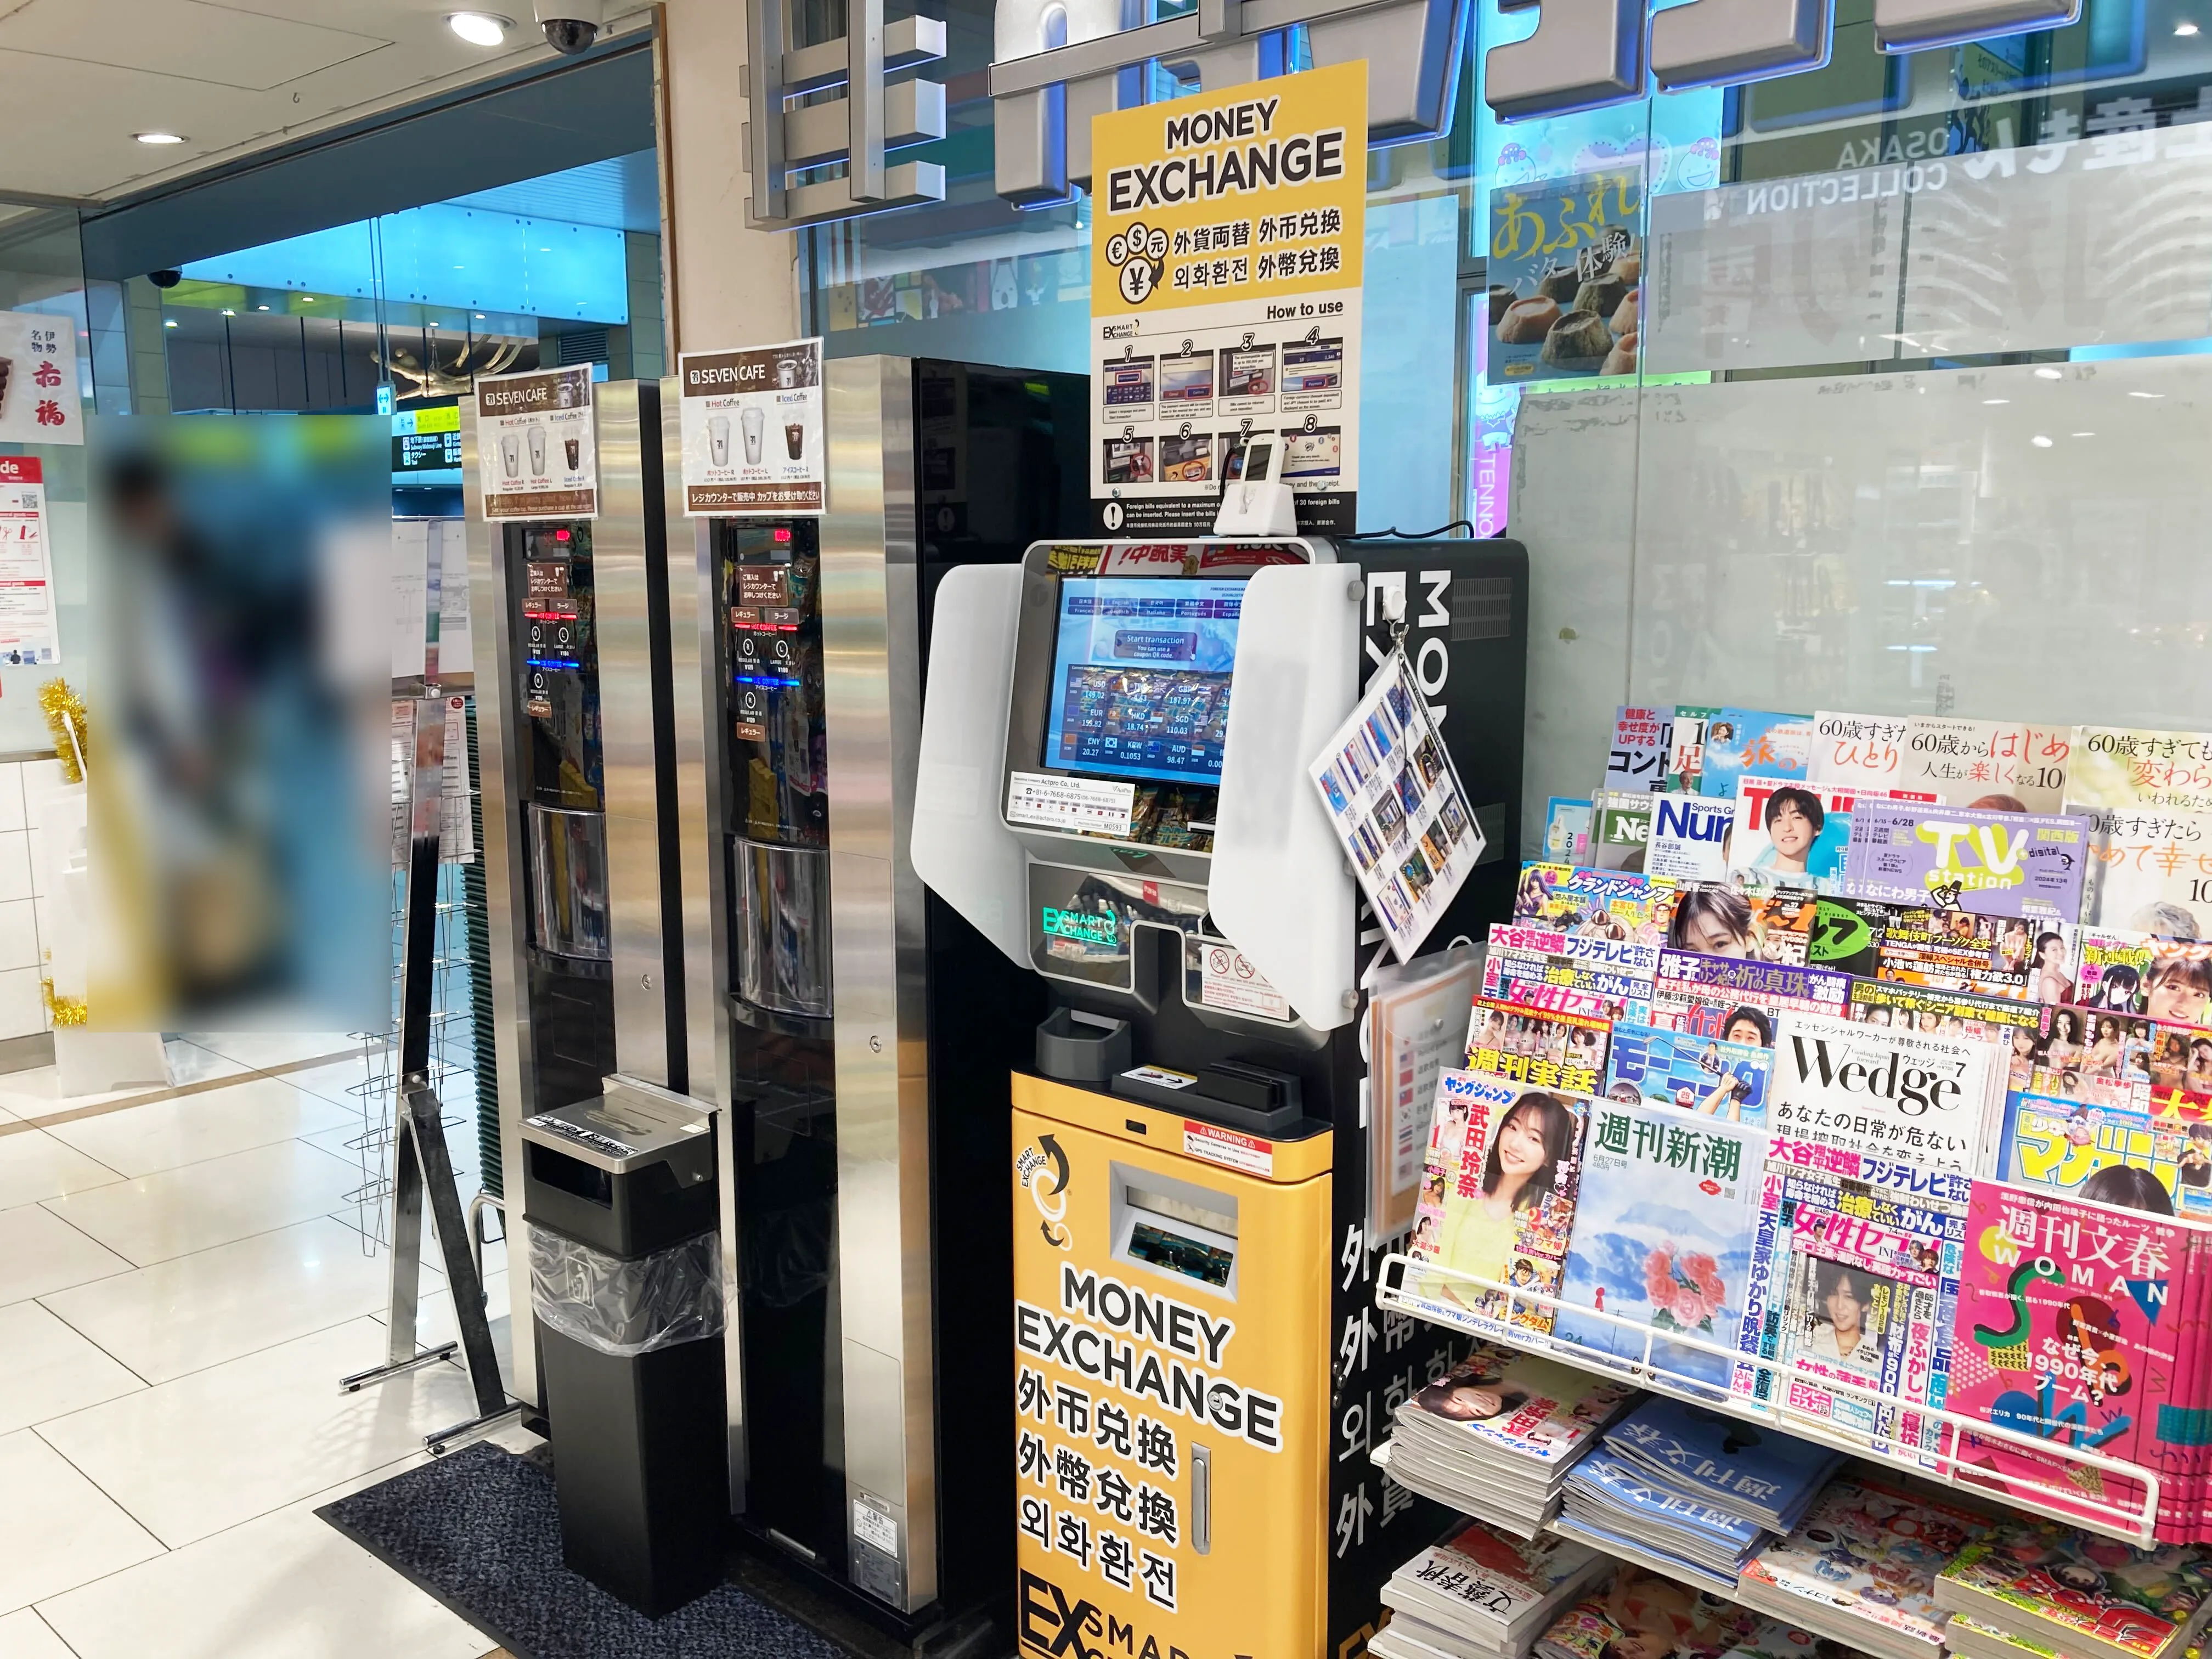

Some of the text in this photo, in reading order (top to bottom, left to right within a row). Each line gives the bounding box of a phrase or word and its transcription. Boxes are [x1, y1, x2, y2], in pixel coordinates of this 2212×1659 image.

[1167, 99, 1278, 150] MONEY
[1110, 132, 1342, 212] EXCHANGE
[1174, 208, 1341, 254] 外貨両替 外币兑换
[1258, 246, 1340, 280] 外幣兌換
[1173, 257, 1248, 290] 외화환전
[1267, 300, 1344, 319] How to use
[1113, 324, 1133, 332] SMART
[1125, 326, 1319, 362] 1 2 3 4
[702, 364, 766, 383] SEVEN CAFE
[496, 387, 548, 406] SEVEN CAFE
[712, 398, 740, 408] Hot Coffee
[793, 393, 808, 402] Coffee
[1122, 415, 1317, 442] 5 6 7 8
[1127, 635, 1184, 645] Start transaction
[1085, 690, 1104, 699] 149.02
[1169, 696, 1191, 704] 187.97
[1178, 685, 1192, 693] GBP
[1131, 712, 1146, 720] HKD
[1175, 715, 1189, 724] SGD
[1625, 708, 1655, 721] 健康と
[741, 727, 760, 736] レギュラー
[1126, 723, 1144, 731] 18.74
[1166, 726, 1188, 735] 110.03
[1618, 721, 1661, 735] 幸せ度が
[1127, 741, 1142, 749] KRW
[1171, 744, 1186, 753] AUD
[1618, 734, 1656, 747] UPする
[1082, 748, 1185, 764] 20.27 0.1053 98.47
[1833, 740, 1898, 769] ひとり
[1032, 789, 1081, 800] +81-6-7668-6875
[1691, 803, 1723, 814] Sports
[1103, 823, 1122, 831] M0593
[1892, 817, 1914, 827] 6/28
[2036, 827, 2080, 844] 関西版
[1922, 820, 2029, 874] TV
[2029, 846, 2060, 859] digital
[1567, 873, 1675, 903] グランドジャンプ
[1928, 869, 2012, 890] station
[1866, 883, 1932, 903] なにわ男子
[1063, 912, 1102, 927] SMART
[1063, 925, 1103, 941] CHANGE
[1567, 937, 1632, 964] フジテレビ
[1543, 966, 1576, 986] 治療
[1596, 973, 1629, 995] がん
[1631, 988, 1650, 997] リスト
[1795, 1021, 1971, 1057] エッセンシャルワーカーが尊敬される社会へ
[1852, 1048, 1890, 1060] Guiding Japan
[1857, 1057, 1880, 1065] forward
[1467, 1046, 1598, 1094] 週刊実話
[1788, 1035, 1961, 1116] Wedge
[1903, 1054, 1936, 1069] ウェッジ
[1955, 1063, 1967, 1077] 7
[1444, 1077, 1516, 1104] ヤングジャンプ
[1778, 1102, 1966, 1151] あなたの日常が危ない
[1194, 1137, 1210, 1146] Security
[1210, 1141, 1227, 1150] Cameras
[1207, 1128, 1248, 1147] WARNING
[1594, 1110, 1742, 1182] 週刊新潮
[1016, 1147, 1035, 1171] SMART
[1203, 1149, 1223, 1159] TRACKING
[1223, 1156, 1239, 1164] SYSTEM
[1457, 1104, 1491, 1199] 武田玲奈
[1022, 1155, 1046, 1187] EXCHANGE
[1592, 1161, 1610, 1171] 480円
[1593, 1155, 1628, 1170] 6月27日号
[1863, 1158, 1950, 1197] フジテレビ
[1836, 1190, 1873, 1220] 治療
[1900, 1209, 1944, 1237] がん
[1994, 1204, 2171, 1279] 週刊文春
[1993, 1244, 2168, 1307] WOMAN
[1064, 1267, 1231, 1364] MONEY
[1908, 1322, 1929, 1394] 夜ふかし
[1017, 1304, 1277, 1447] EXCHANGE
[2026, 1352, 2118, 1393] 1990年代
[1791, 1386, 1831, 1406] コンビニ
[2033, 1374, 2104, 1406] ブーム?
[1018, 1368, 1176, 1477] 外币兑换
[1018, 1433, 1177, 1545] 外幣兌換
[1020, 1499, 1175, 1610] 외화환전
